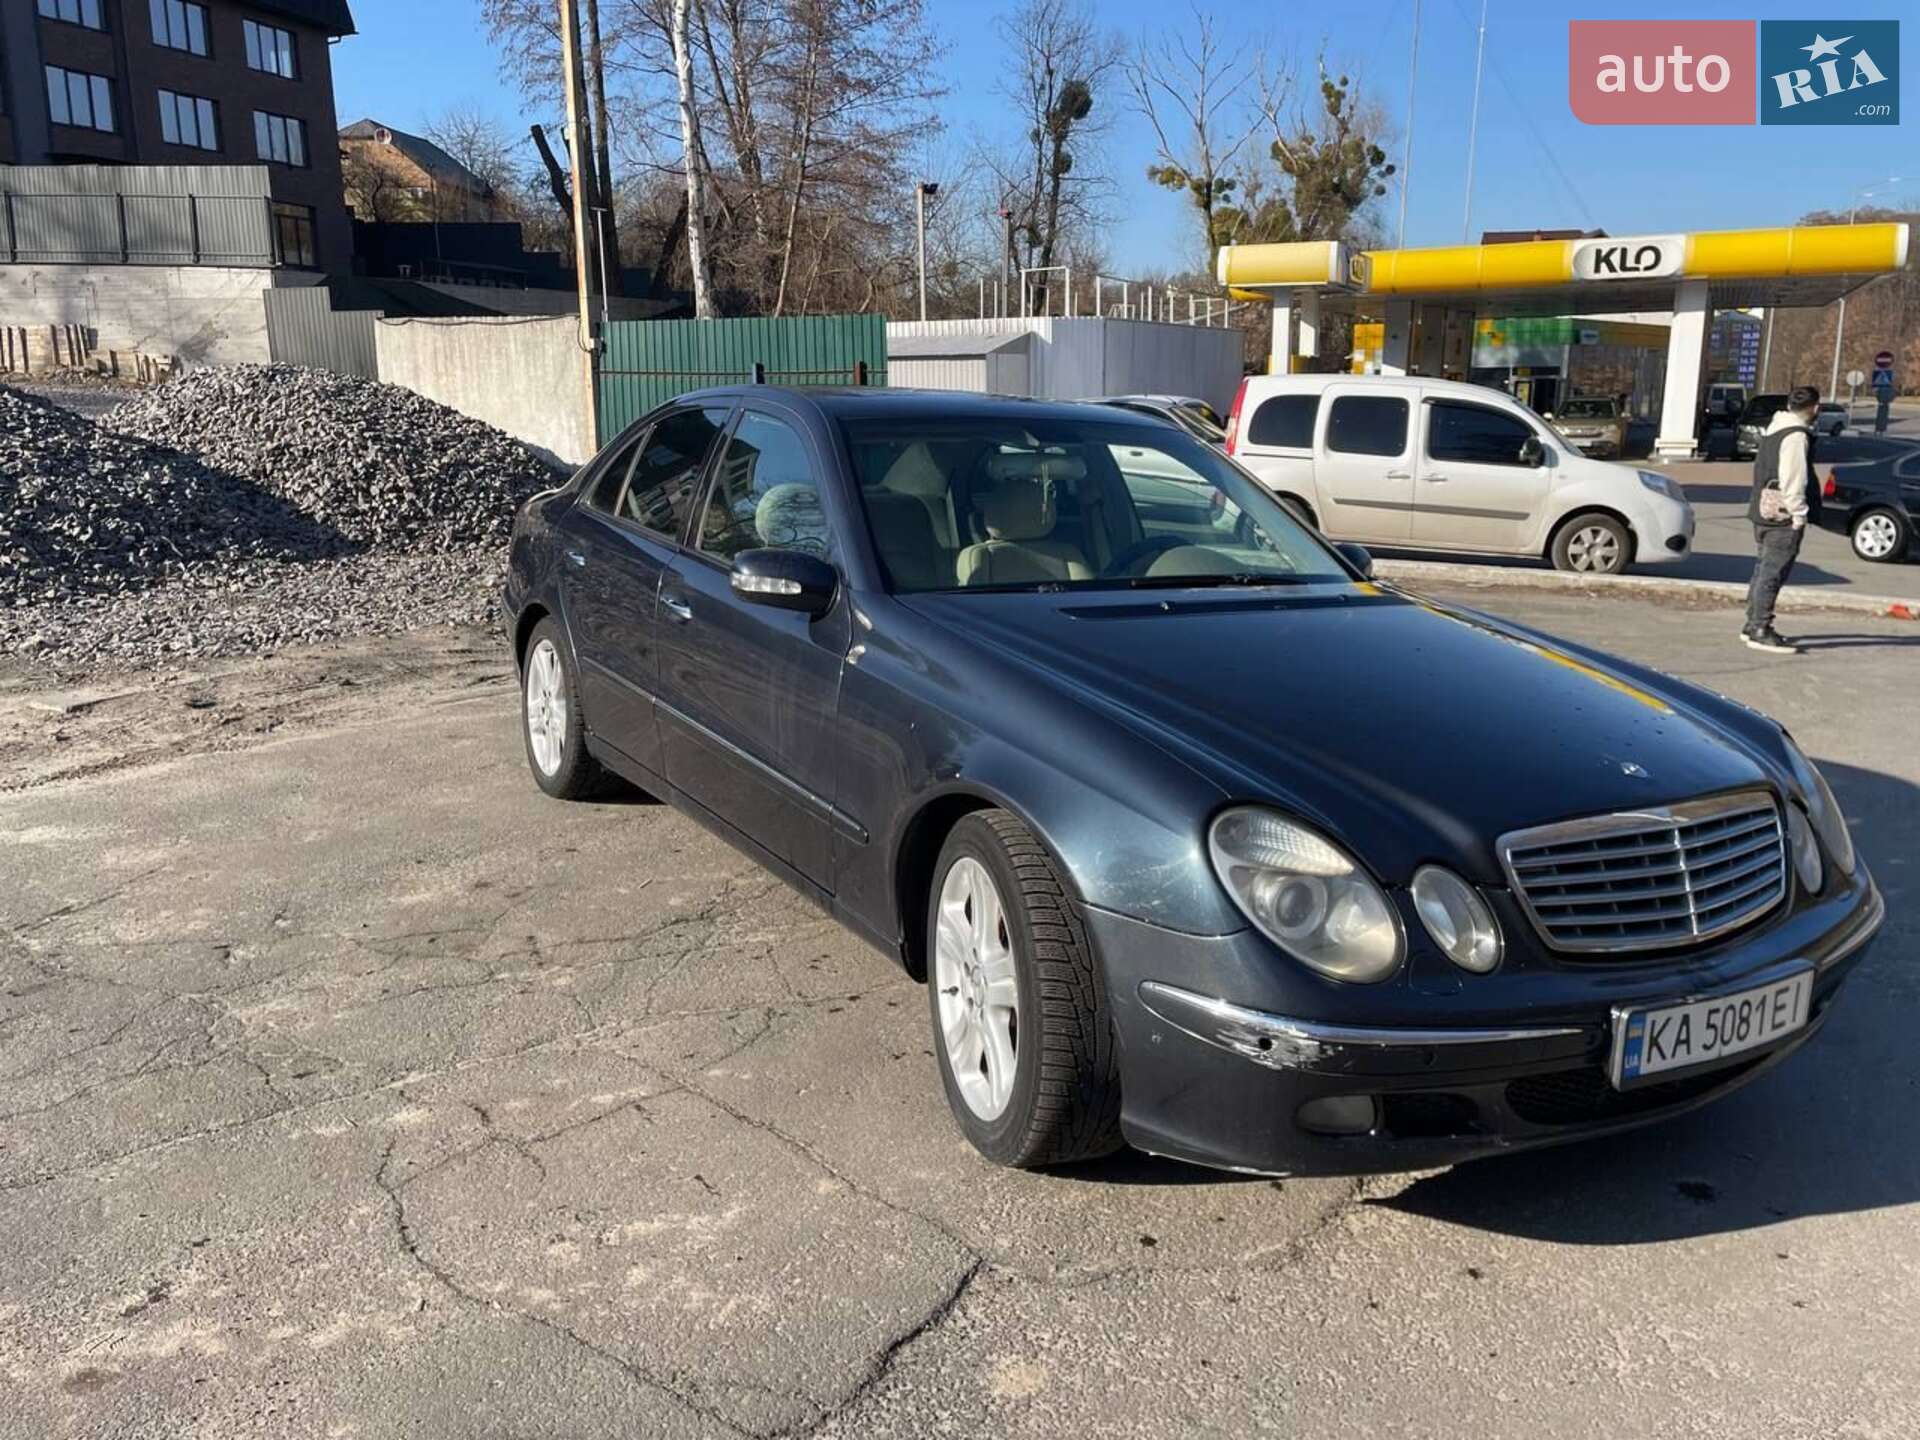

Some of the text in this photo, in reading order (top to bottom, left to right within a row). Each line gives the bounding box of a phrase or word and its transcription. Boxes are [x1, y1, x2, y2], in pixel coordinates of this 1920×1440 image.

[1594, 245, 1662, 274] KLO
[1647, 1013, 1691, 1063] KA
[1624, 1053, 1639, 1069] UA
